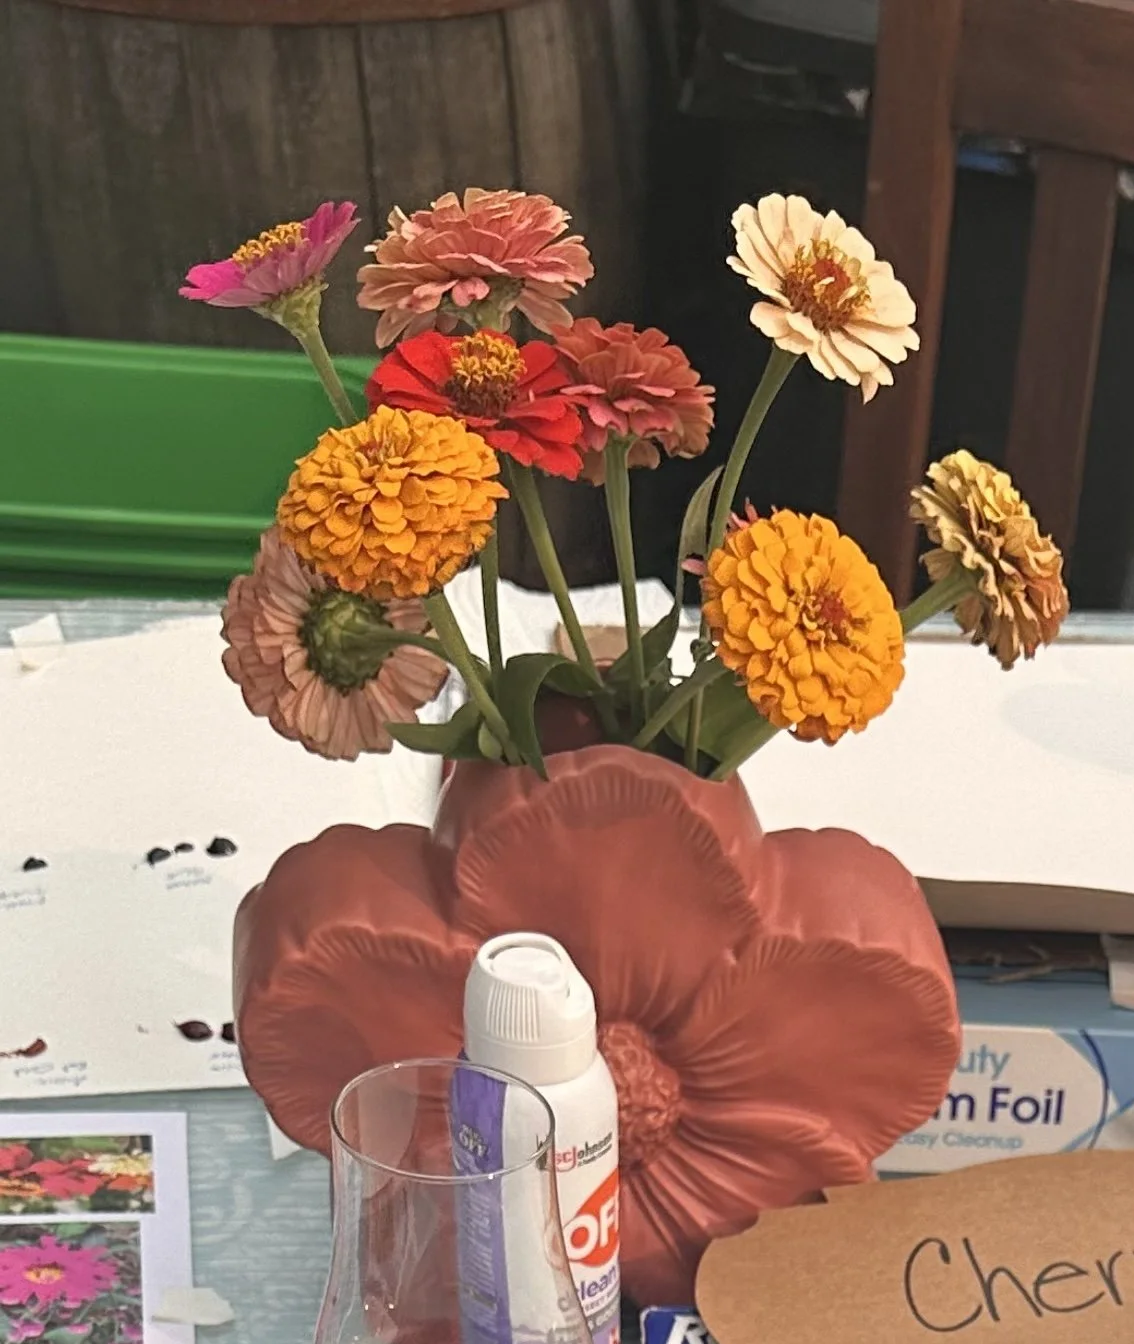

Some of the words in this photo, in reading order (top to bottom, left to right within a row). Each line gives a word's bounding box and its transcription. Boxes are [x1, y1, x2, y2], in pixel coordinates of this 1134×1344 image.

[956, 1044, 1010, 1081] uty
[987, 1085, 1065, 1126] Foil
[897, 1133, 939, 1150] asy
[941, 1130, 1024, 1151] Cleanup
[574, 1265, 618, 1301] lean
